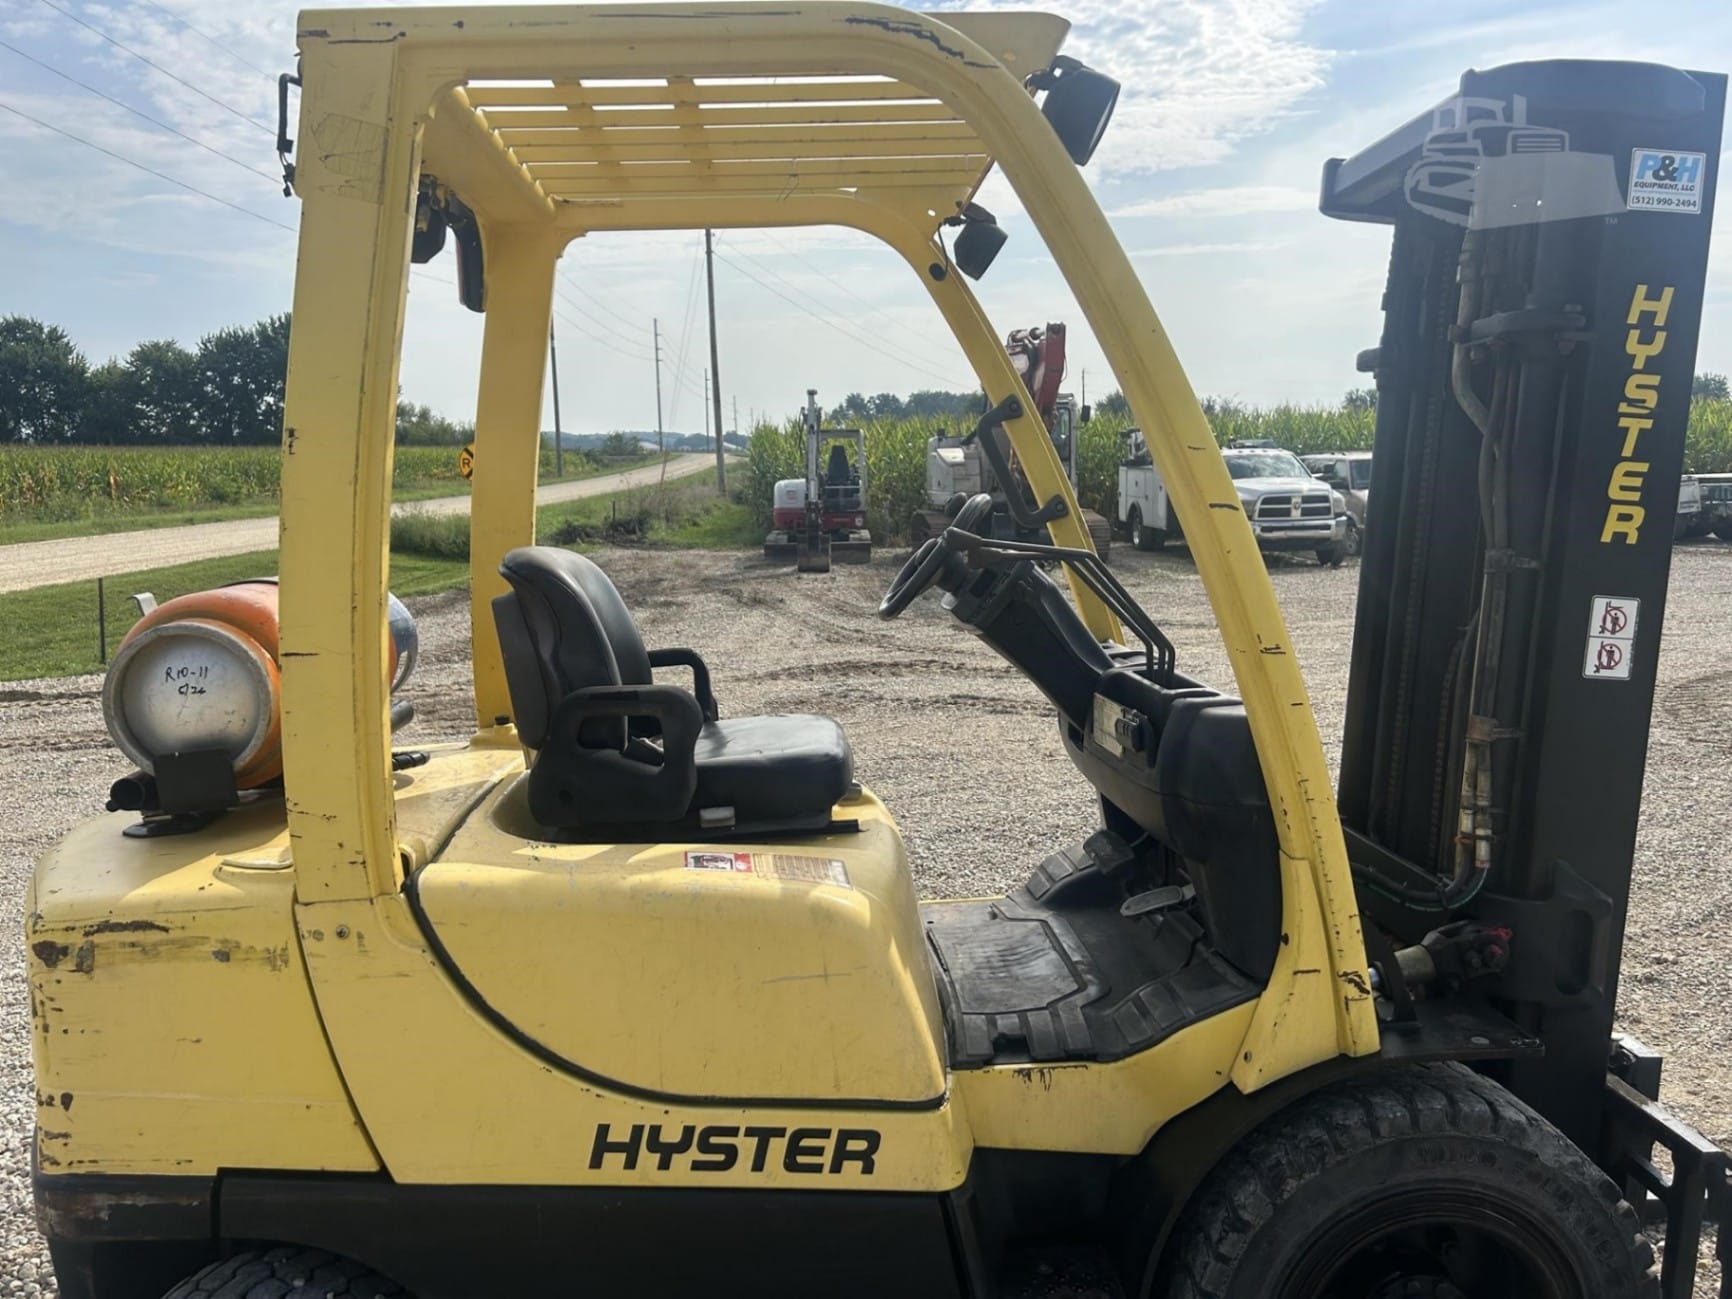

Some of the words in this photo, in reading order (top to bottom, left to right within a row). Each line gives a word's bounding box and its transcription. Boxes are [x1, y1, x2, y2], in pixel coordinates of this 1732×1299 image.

[1636, 154, 1701, 183] P&H
[1633, 181, 1680, 191] EQUIPMENT,
[1681, 183, 1695, 191] LLC
[1631, 195, 1655, 206] (512)
[1655, 197, 1697, 208] 990-2494
[1600, 284, 1675, 545] HYSTER
[588, 1123, 882, 1175] HYSTER
